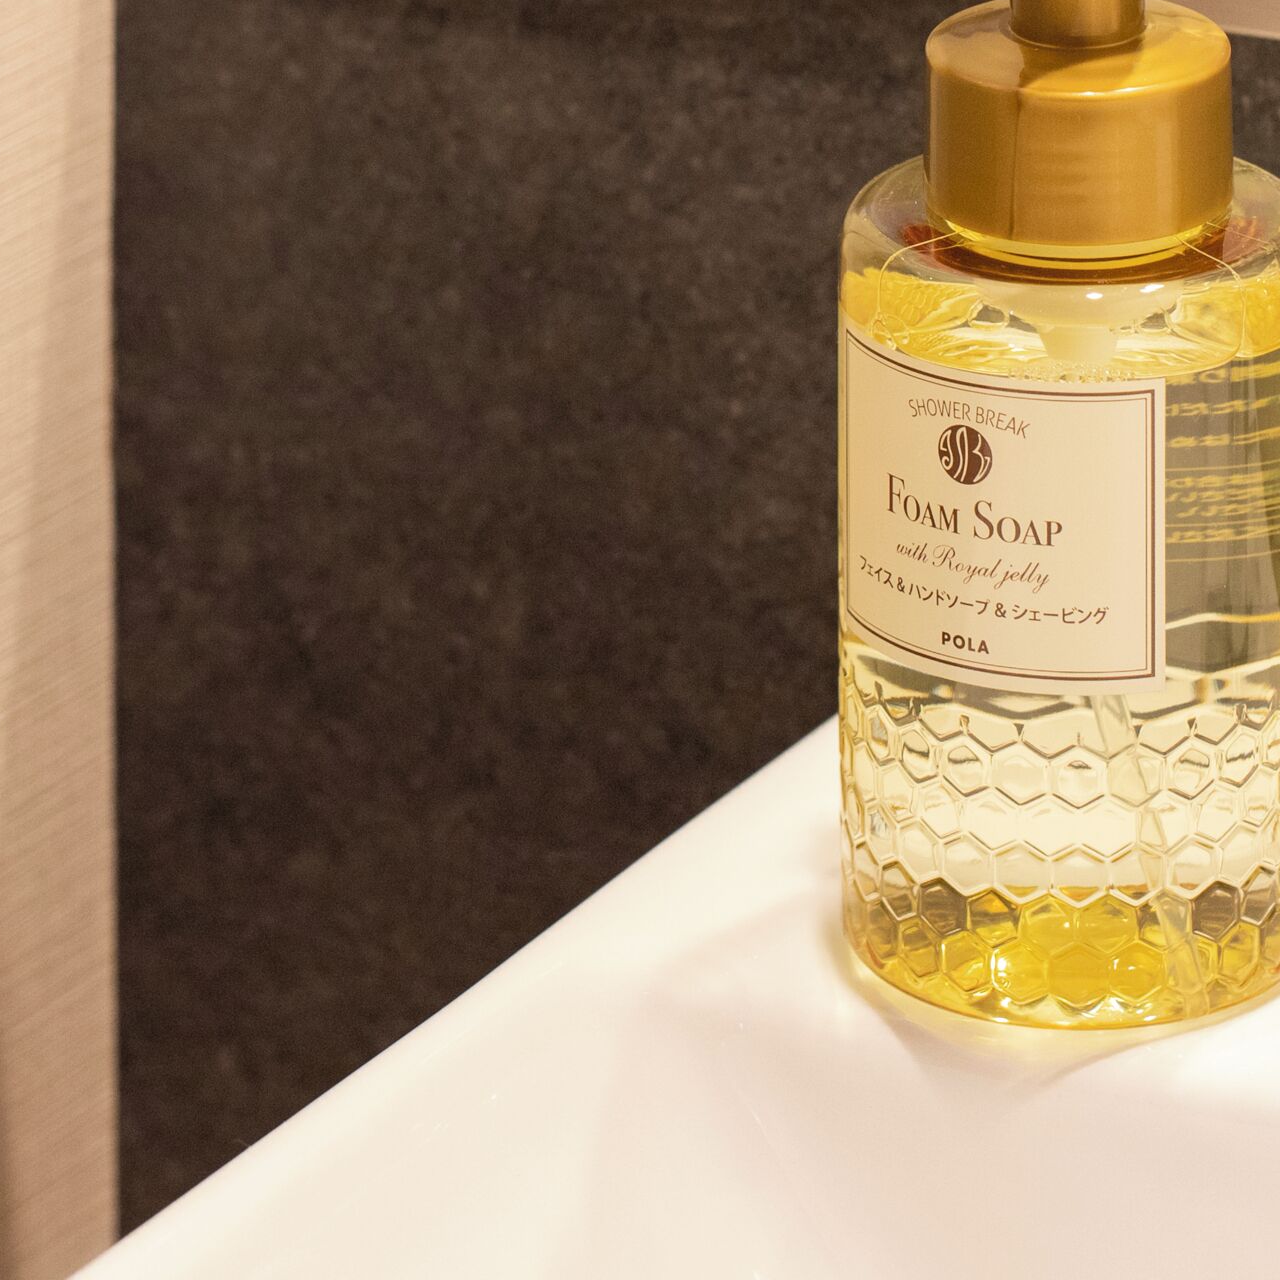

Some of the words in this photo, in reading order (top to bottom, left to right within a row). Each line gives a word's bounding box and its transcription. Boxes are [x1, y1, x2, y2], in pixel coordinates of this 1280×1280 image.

[908, 398, 971, 421] SHOWER
[975, 406, 1031, 439] BREAK
[886, 472, 961, 535] FOAM
[973, 499, 1063, 548] SOAP
[896, 542, 929, 563] with
[932, 543, 1003, 585] Royal
[993, 562, 1051, 594] jelly
[941, 631, 990, 655] POLA
